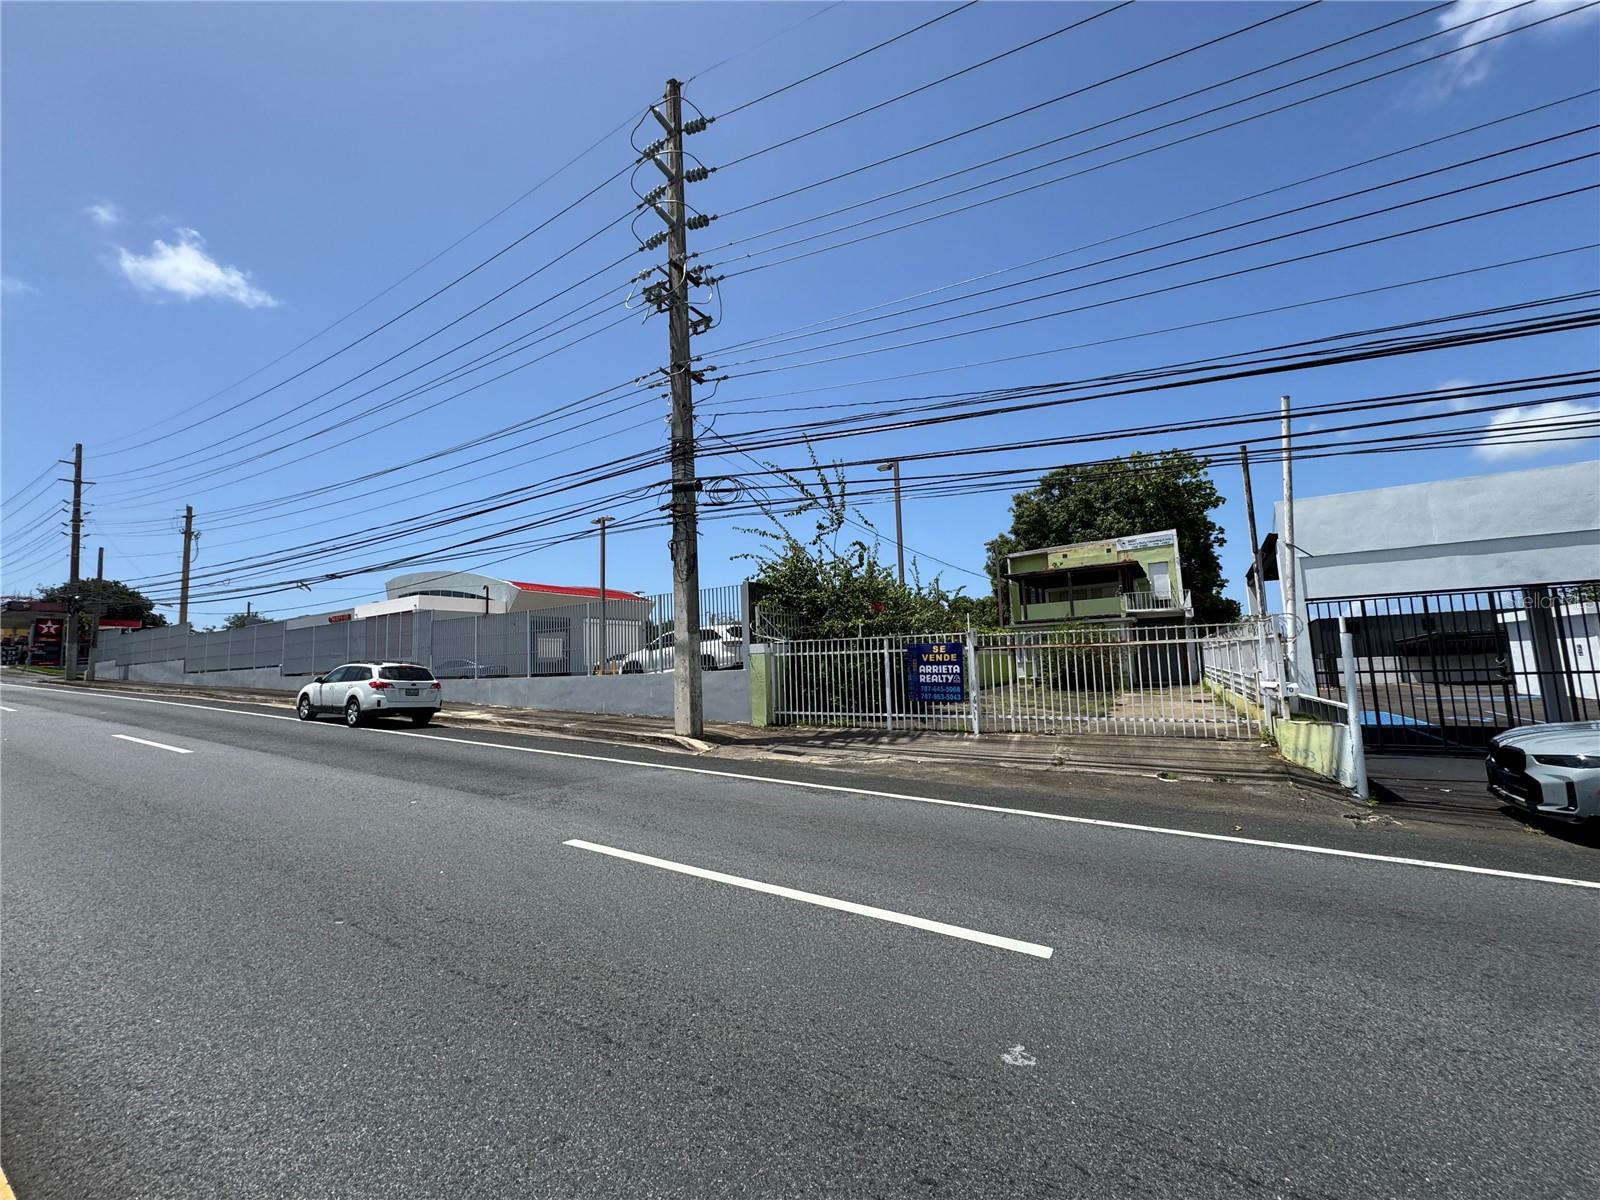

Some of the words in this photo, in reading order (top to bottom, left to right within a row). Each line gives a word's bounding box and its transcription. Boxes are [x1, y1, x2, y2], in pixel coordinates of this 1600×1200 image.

[932, 645, 945, 653] SE
[919, 665, 960, 673] ARRIETA
[919, 674, 953, 682] REALTY
